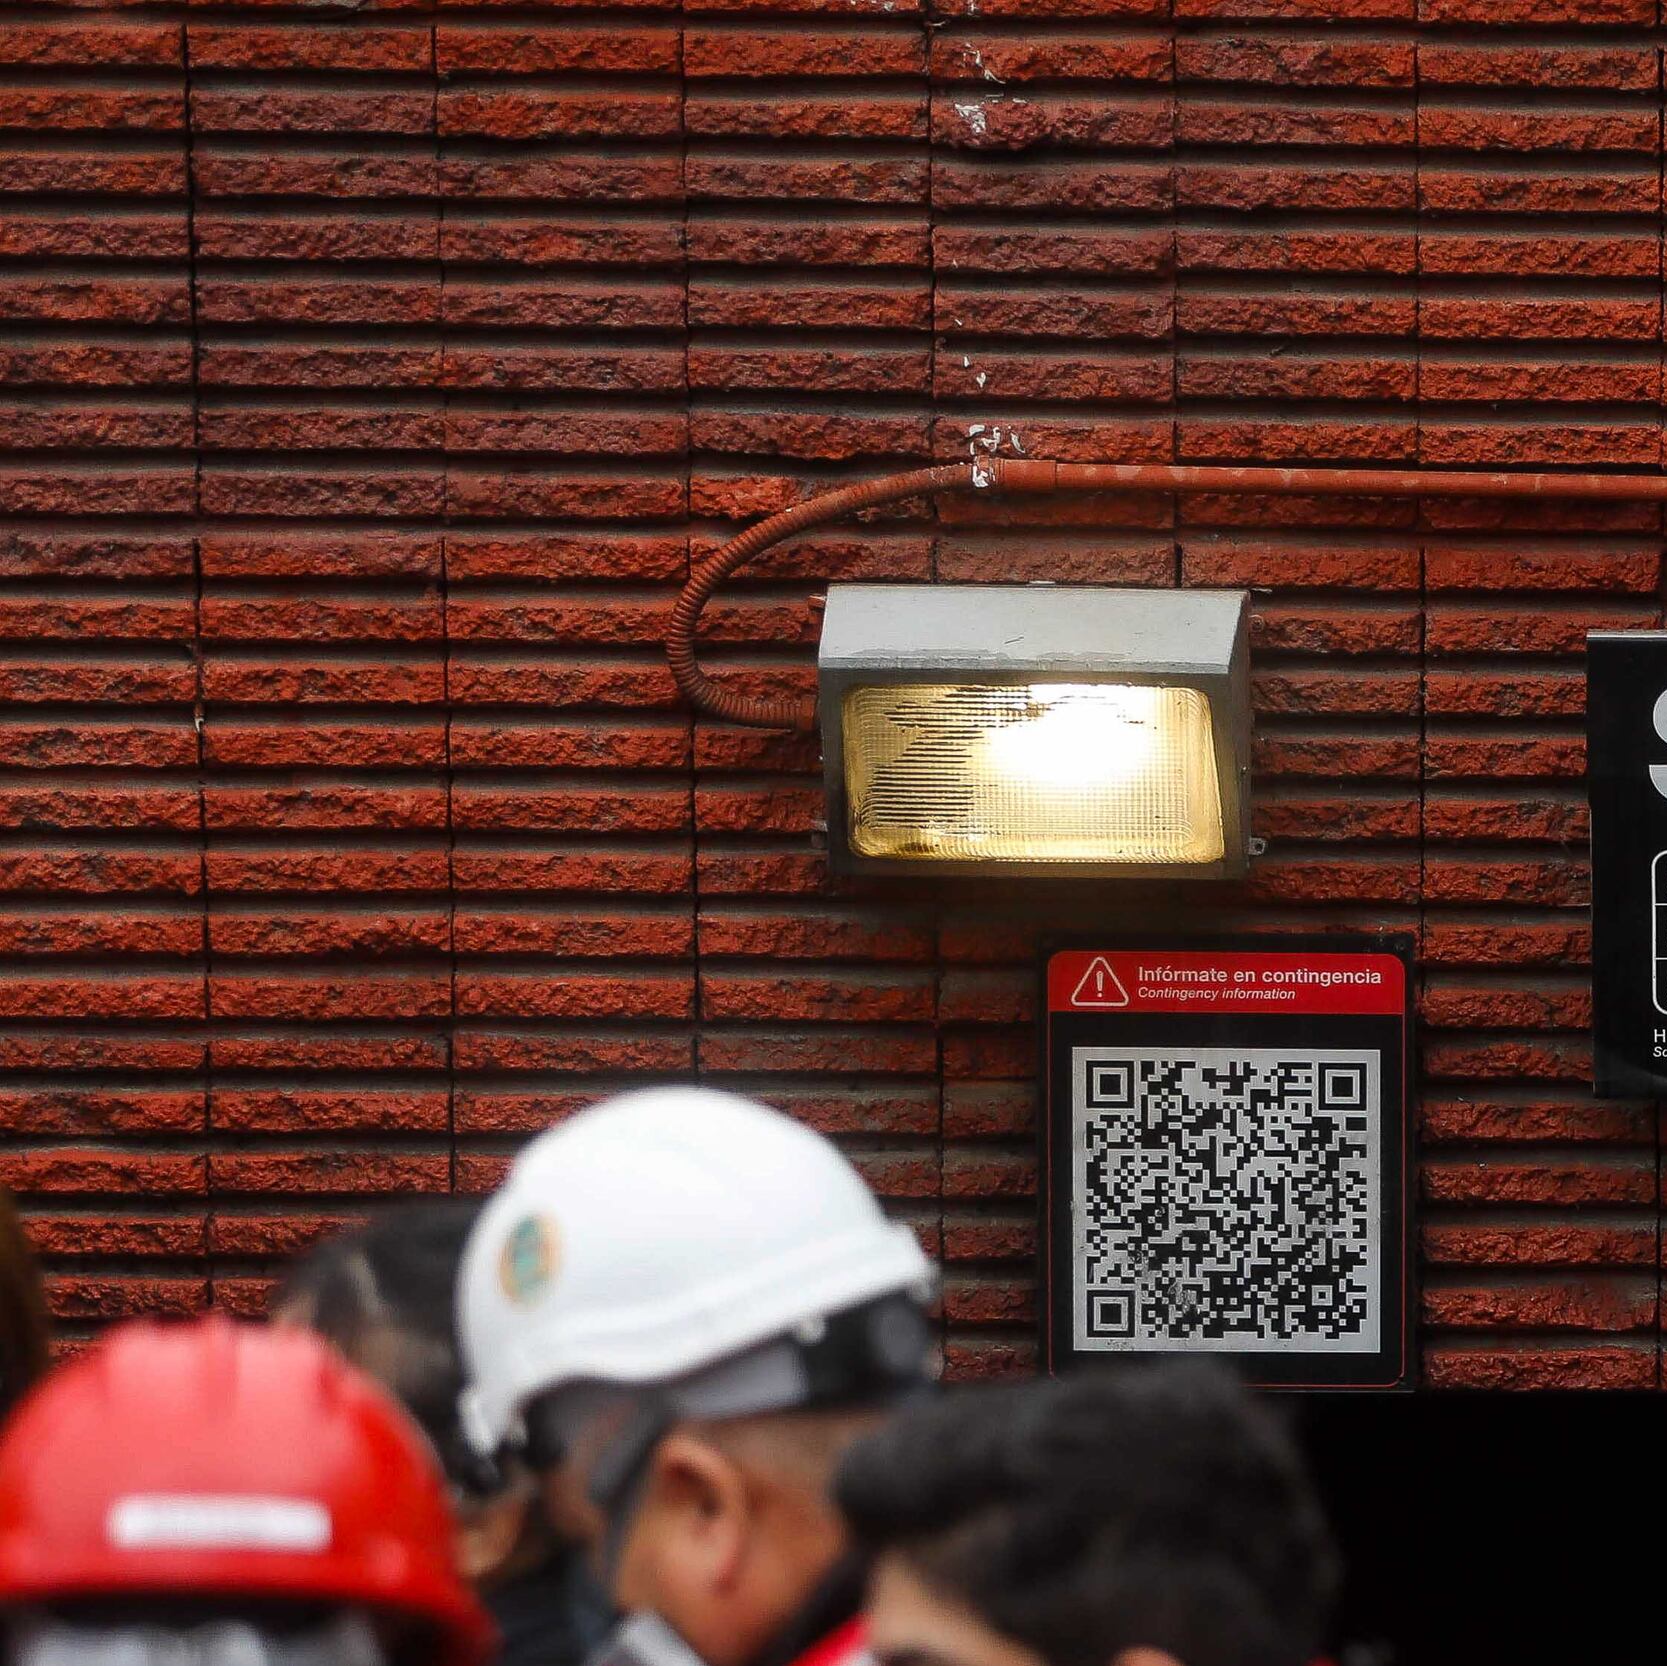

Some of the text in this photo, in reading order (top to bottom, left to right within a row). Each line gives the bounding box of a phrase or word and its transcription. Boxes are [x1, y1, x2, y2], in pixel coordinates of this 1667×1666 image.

[1139, 966, 1381, 987] Infórmate en contingencia
[1139, 987, 1295, 1001] Contingency information
